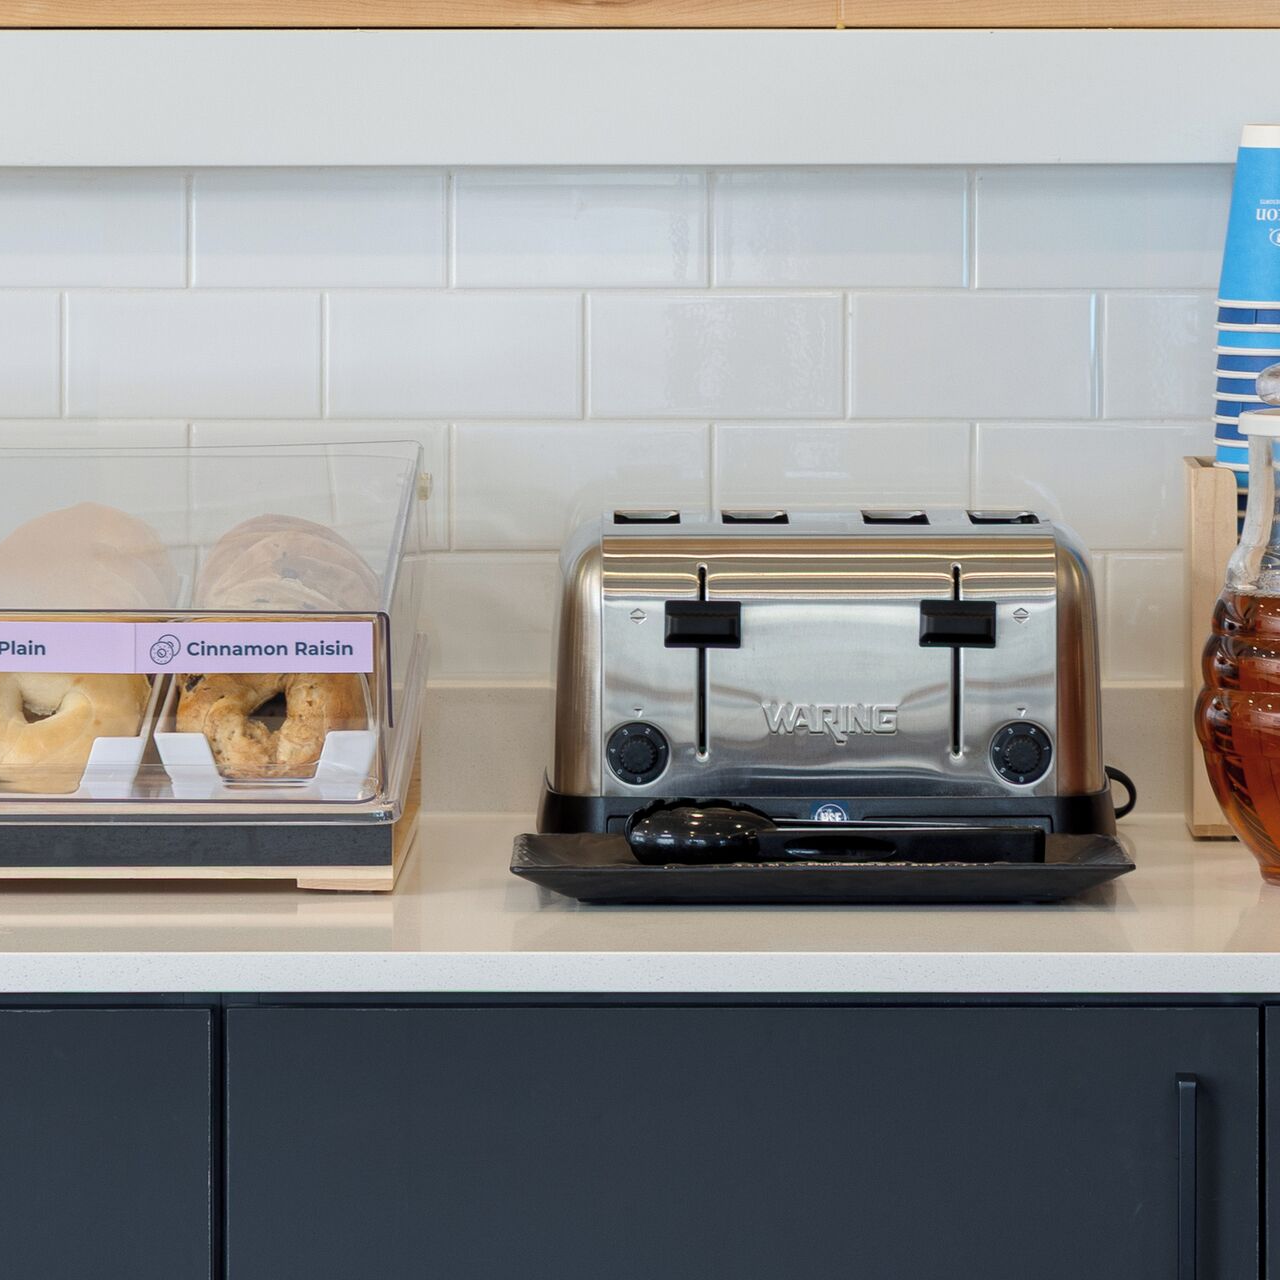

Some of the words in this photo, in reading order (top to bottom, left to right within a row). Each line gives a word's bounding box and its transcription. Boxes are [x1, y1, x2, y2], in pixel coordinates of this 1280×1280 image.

[186, 641, 289, 656] Cinnamon
[295, 640, 354, 656] Raisin
[761, 703, 898, 745] WARING
